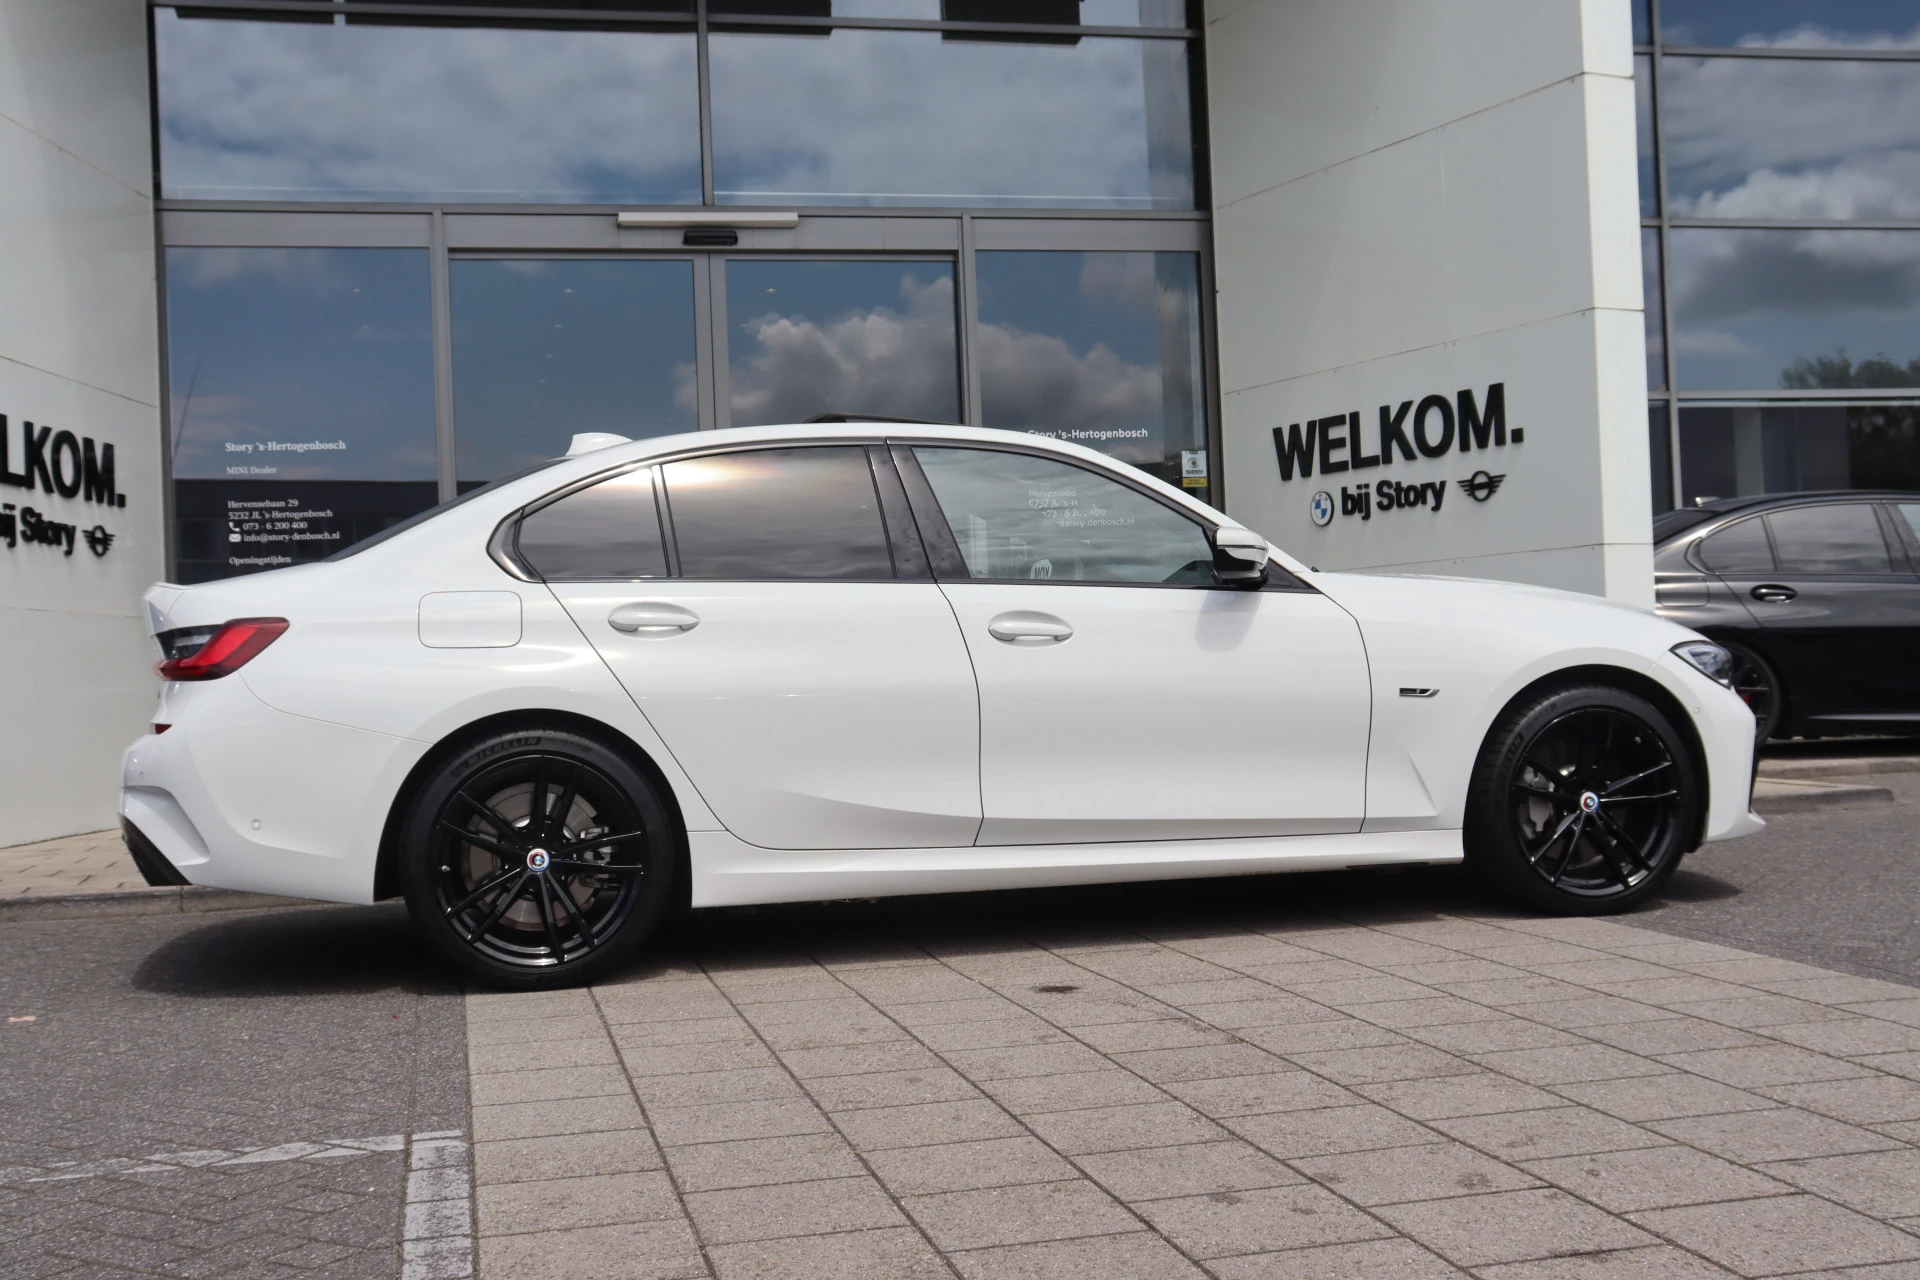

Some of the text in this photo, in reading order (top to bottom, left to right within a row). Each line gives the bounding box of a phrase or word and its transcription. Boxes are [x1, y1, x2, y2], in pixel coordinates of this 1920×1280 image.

[1058, 428, 1148, 440] 's-Hertogenbosch
[1272, 382, 1524, 482] WELKOM.
[225, 440, 346, 453] Story 's-Hertogenbosch
[226, 466, 277, 474] MINI Dealer
[1028, 489, 1076, 498] Hervenseba
[228, 499, 298, 509] Hervensebaan 29
[1341, 480, 1447, 521] bij Story
[228, 509, 333, 520] 5232 JL 's-Hertogenbosch
[242, 522, 259, 530] 073
[265, 522, 272, 530] 6
[291, 521, 307, 529] 400
[20, 506, 76, 557] Story
[243, 531, 340, 543] info@story-denbosch.nl
[229, 555, 292, 566] Openingstijden
